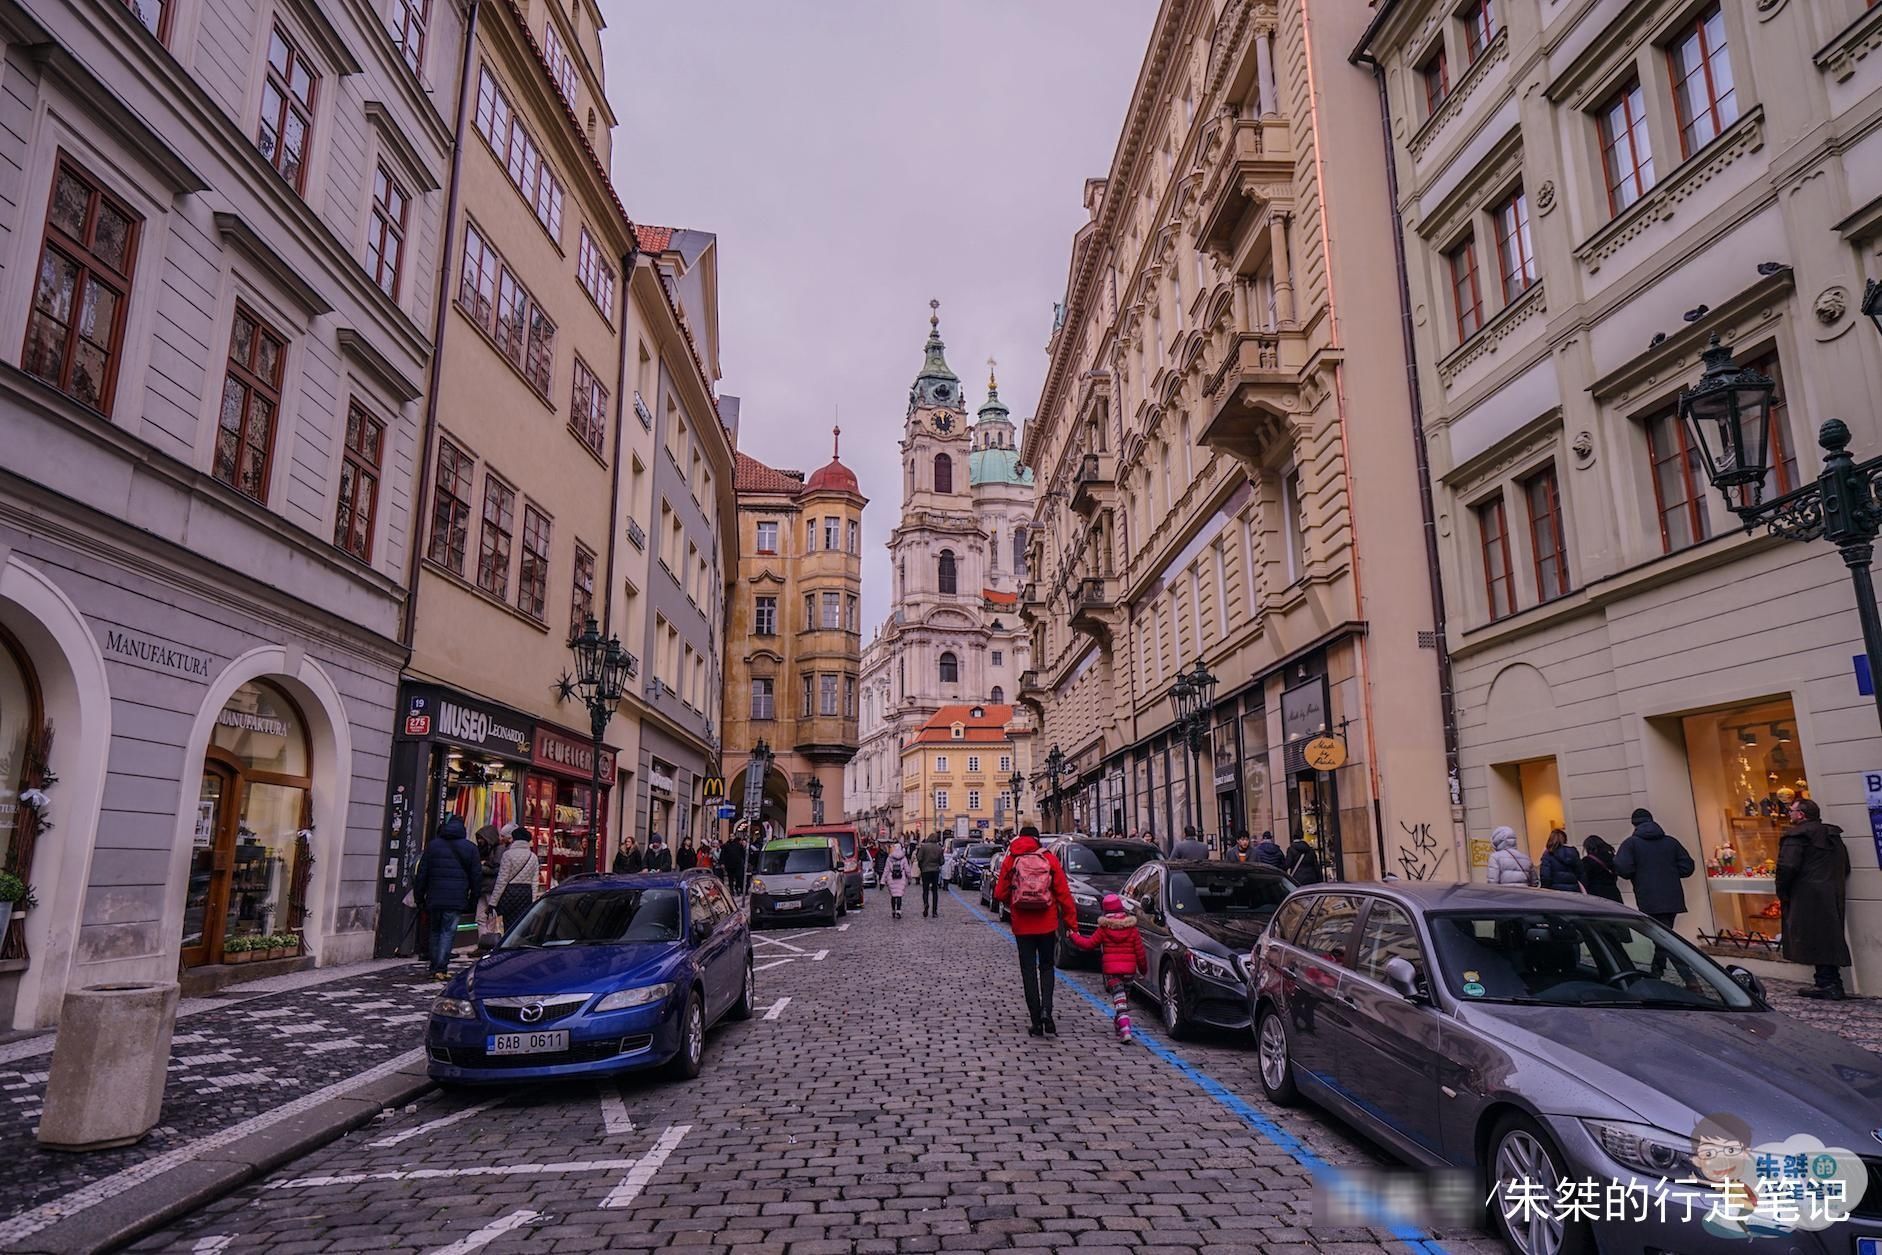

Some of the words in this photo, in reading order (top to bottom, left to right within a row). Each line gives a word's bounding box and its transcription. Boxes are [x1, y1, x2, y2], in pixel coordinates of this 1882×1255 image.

[415, 698, 425, 708] 19
[410, 718, 426, 727] 275
[439, 701, 487, 743] MUSEO
[542, 738, 595, 771] JEWELLER
[497, 1036, 520, 1050] 6AB
[530, 1033, 562, 1048] 0611
